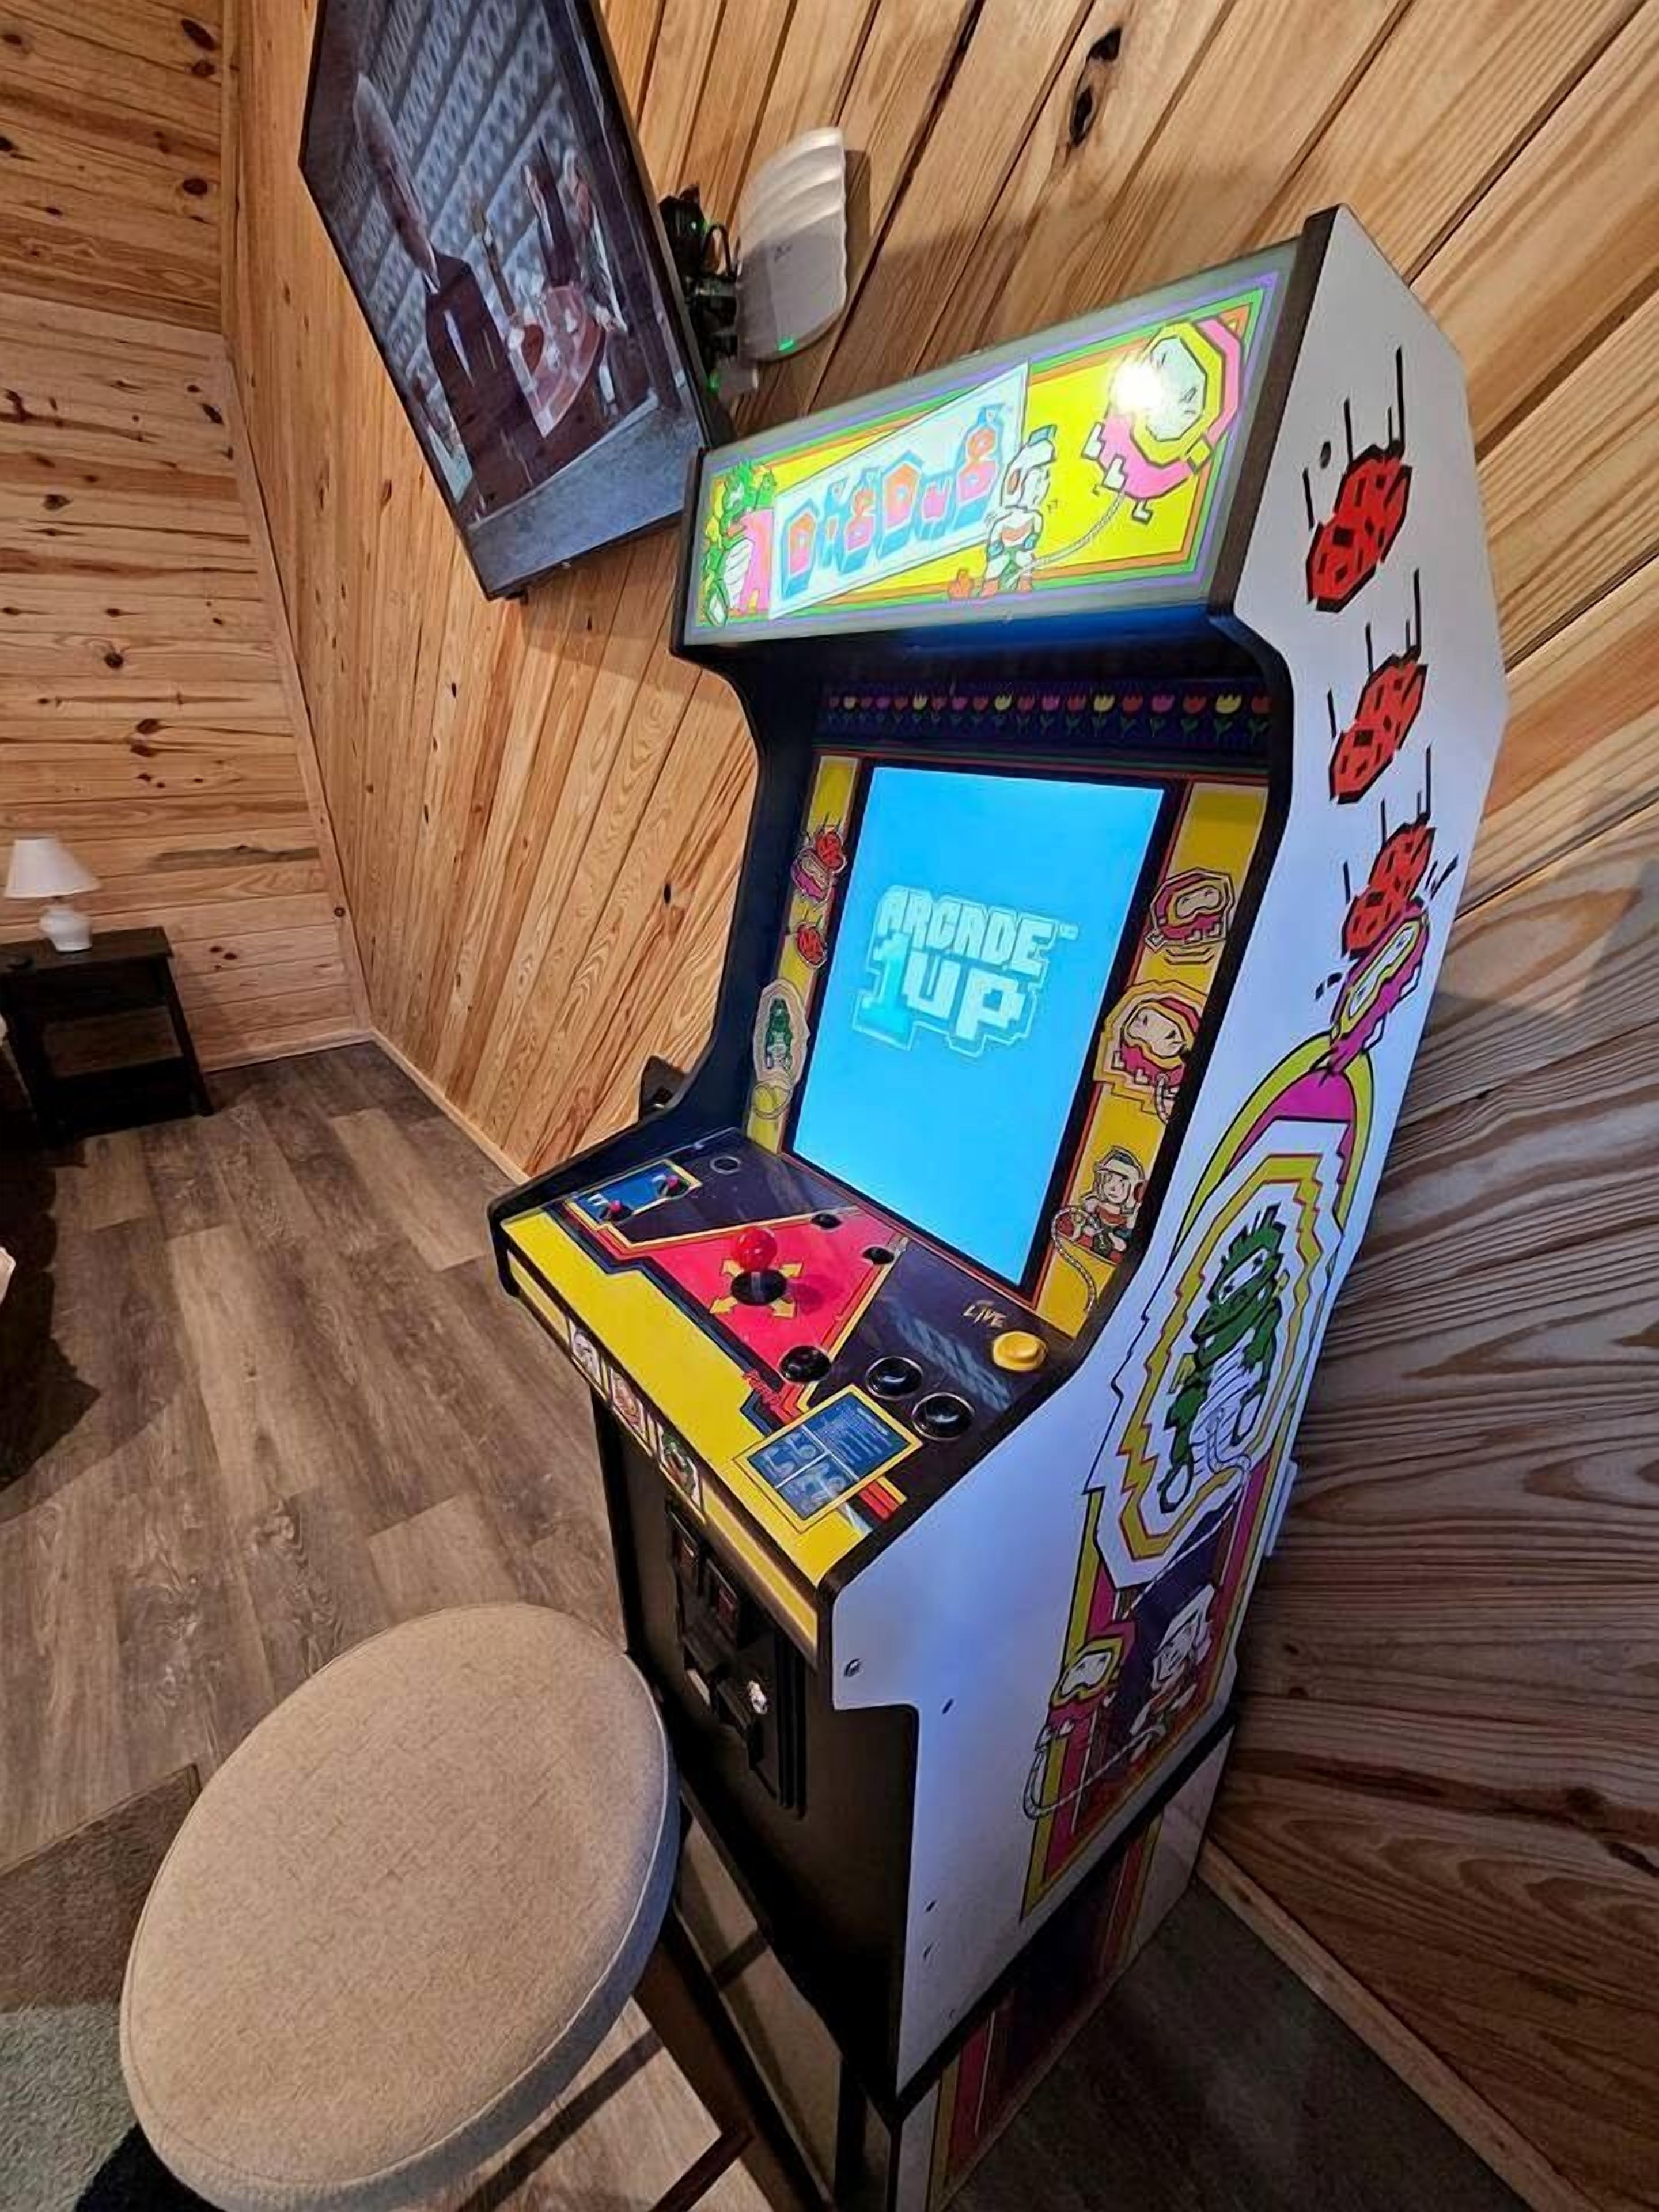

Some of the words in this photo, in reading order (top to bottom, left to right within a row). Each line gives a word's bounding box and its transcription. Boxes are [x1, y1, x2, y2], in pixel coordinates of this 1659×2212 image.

[876, 886, 1055, 976] ARCADE
[862, 931, 1027, 1040] 1UP
[963, 1304, 1007, 1327] LIVE
